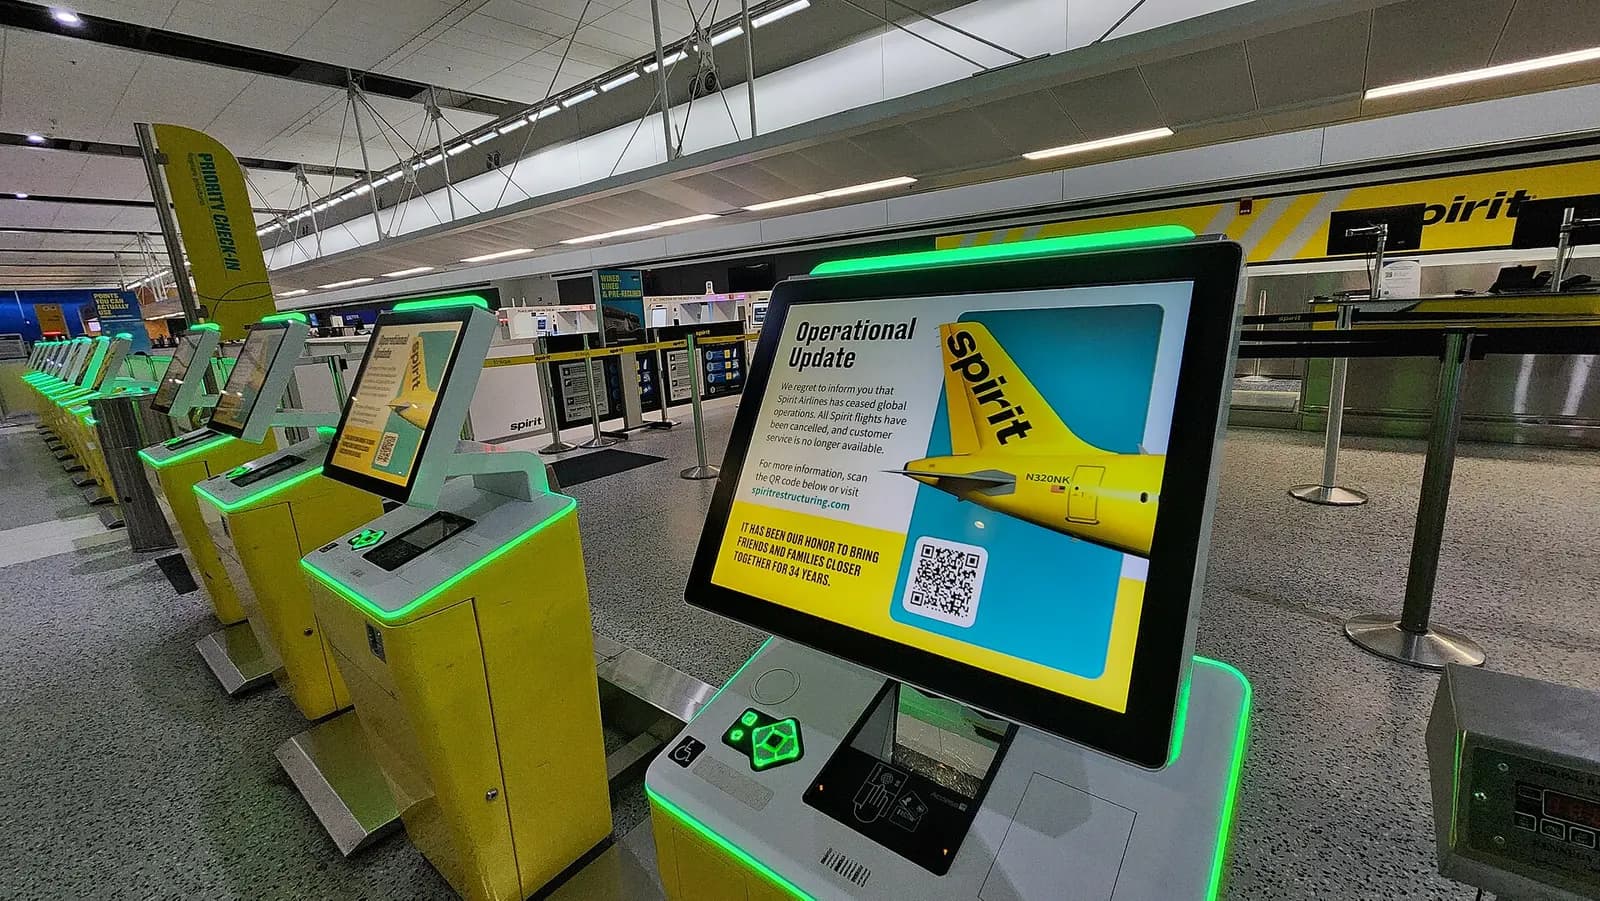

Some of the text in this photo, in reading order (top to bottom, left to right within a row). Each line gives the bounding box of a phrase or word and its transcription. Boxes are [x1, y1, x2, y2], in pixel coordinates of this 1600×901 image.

[198, 153, 240, 271] PRIORITY CHECK-IN
[1421, 189, 1531, 226] pirit
[796, 317, 917, 345] Operational
[789, 347, 856, 372] Update
[781, 382, 894, 396] We regret to inform you that
[947, 330, 1032, 446] spirit
[777, 395, 907, 412] Spirit Airlines has ceased global
[510, 416, 543, 431] spirit
[773, 408, 907, 426] operations. All Spirit flights have
[770, 420, 892, 440] been cancelled, and customer
[766, 433, 884, 454] service is no longer available.
[759, 459, 867, 482] For more information, scan
[1025, 472, 1070, 484] N320NK
[755, 472, 858, 497] the QR code below or visit
[751, 486, 850, 511] spiritrestructuring.com
[741, 522, 879, 564] IT HAS BEEN OUR HONOR TO BRING
[733, 551, 831, 587] TOGETHER FOR 34 YEARS.
[737, 536, 861, 577] FRIENDS AND FAMILIES CLOSER
